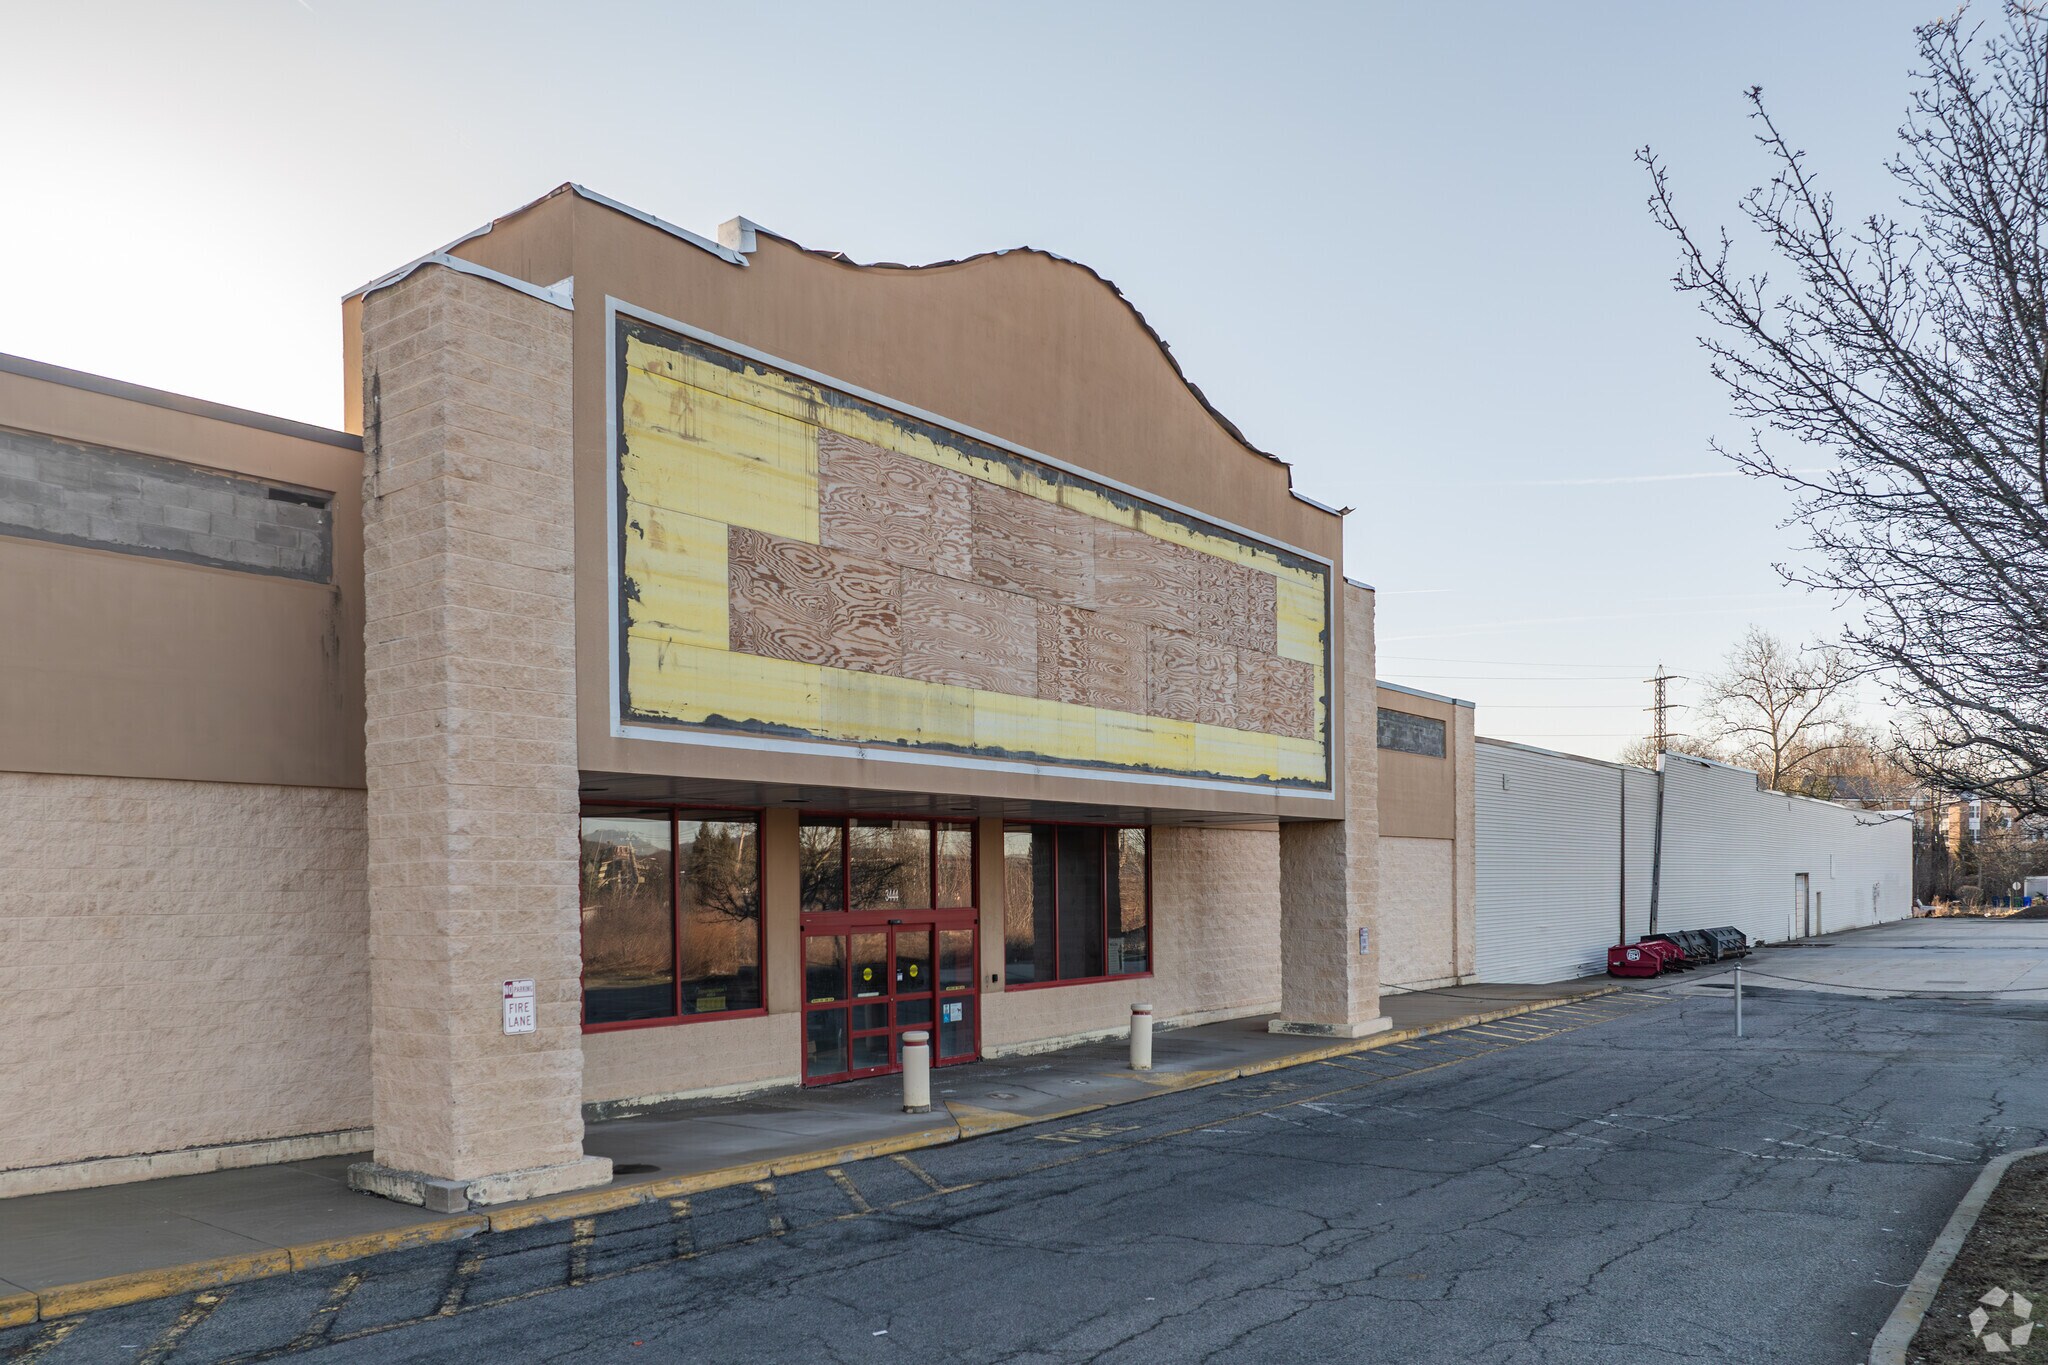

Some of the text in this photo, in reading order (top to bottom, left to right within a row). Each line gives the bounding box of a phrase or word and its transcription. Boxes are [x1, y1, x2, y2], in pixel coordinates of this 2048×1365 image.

[885, 889, 899, 901] 3444
[513, 985, 533, 993] PARKING
[509, 1002, 530, 1013] FIRE
[509, 1016, 531, 1027] LANE
